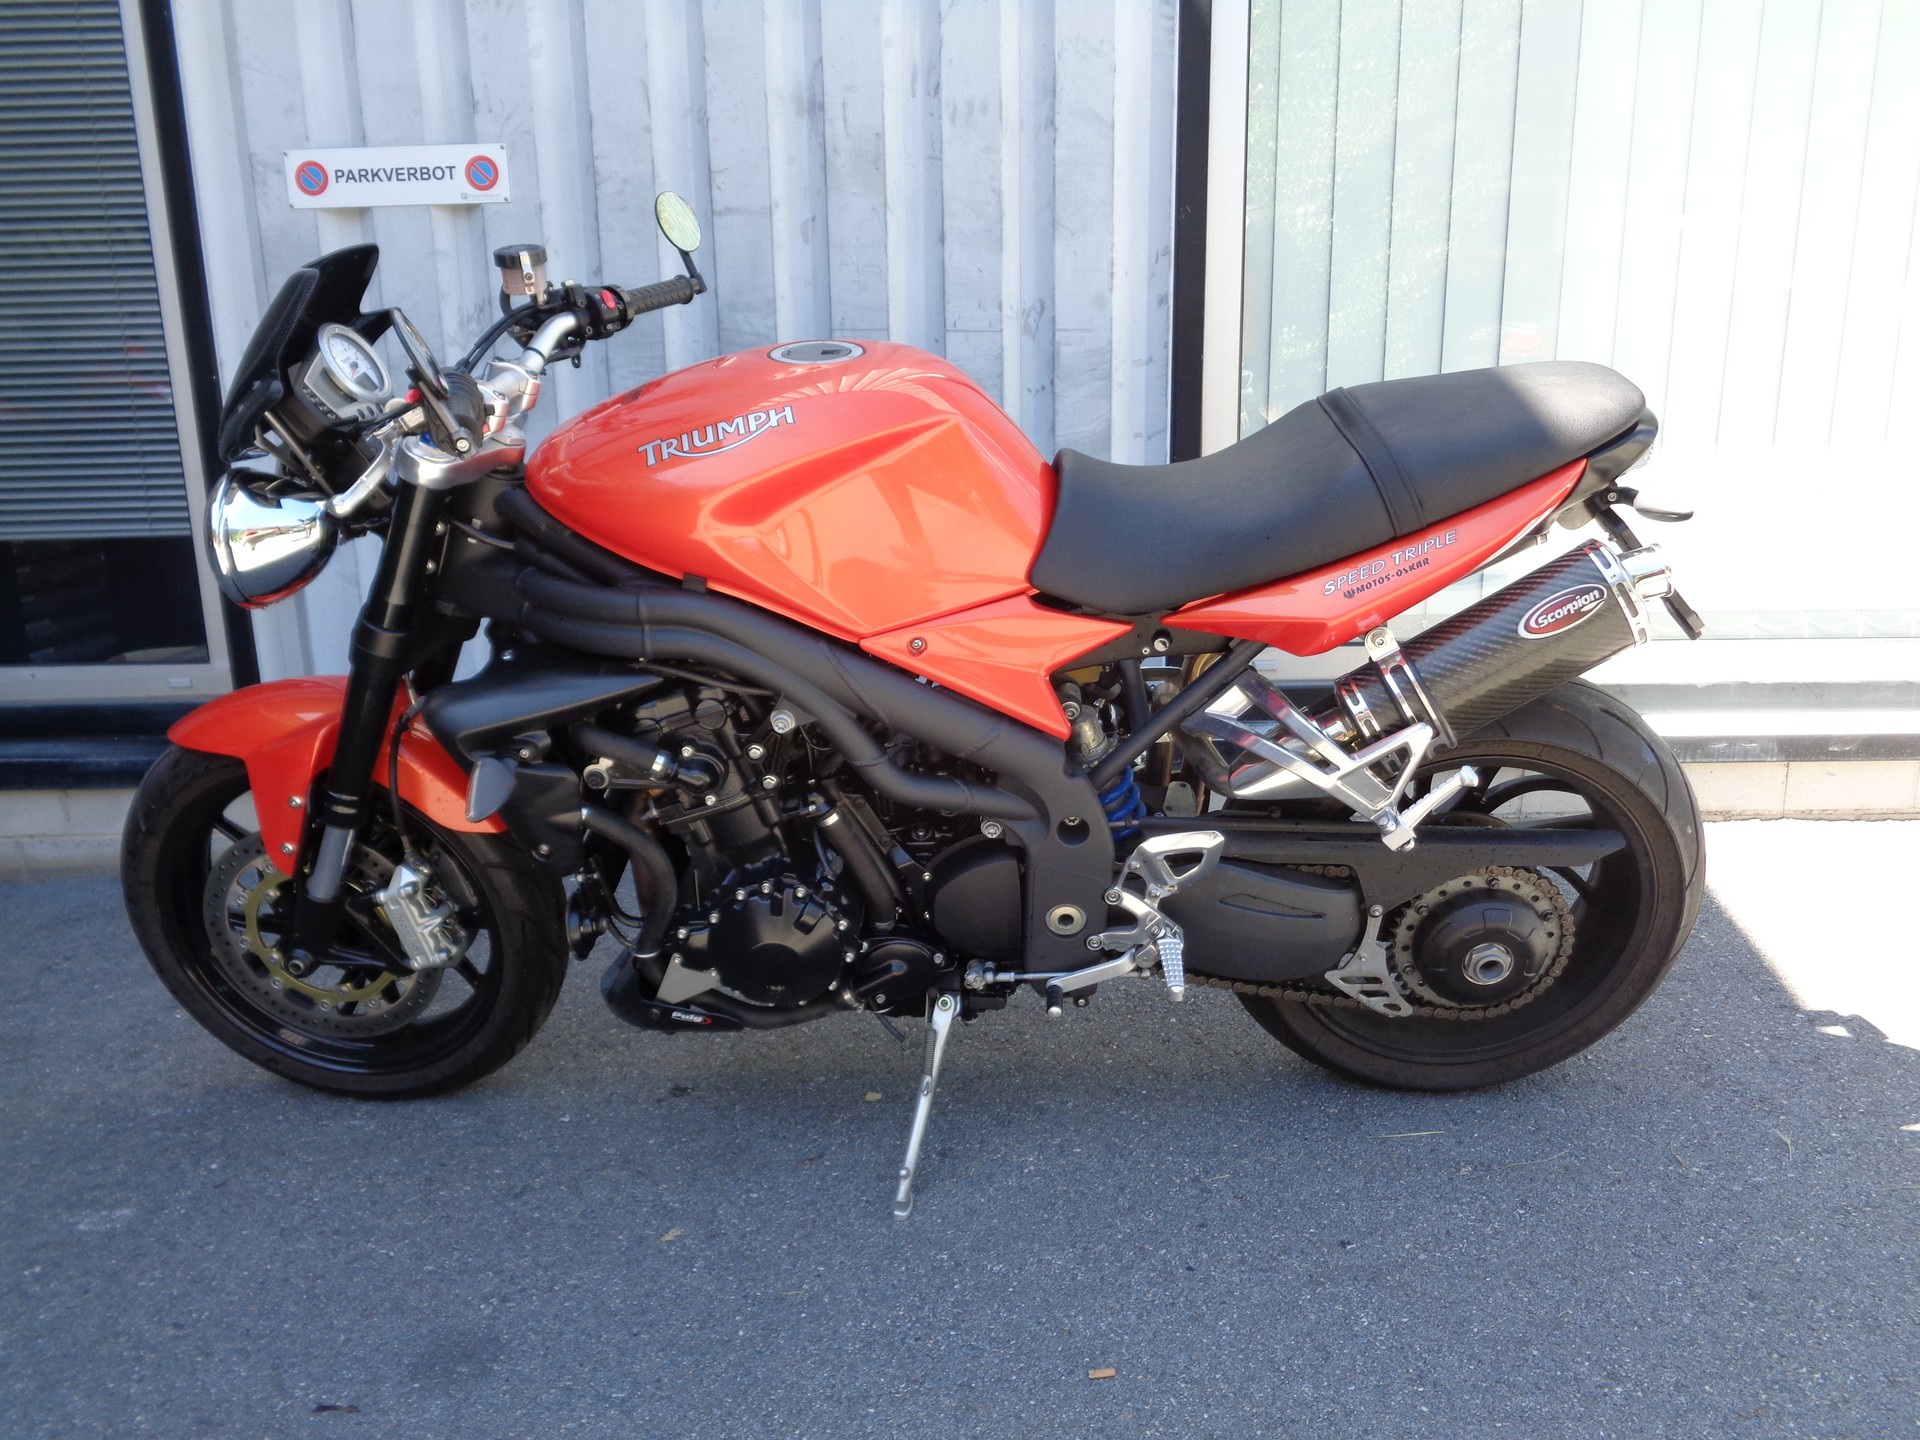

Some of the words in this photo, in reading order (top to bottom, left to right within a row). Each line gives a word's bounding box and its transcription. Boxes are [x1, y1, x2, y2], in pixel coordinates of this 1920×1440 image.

[334, 166, 456, 184] PARKVERBOT
[637, 405, 796, 467] TRIUMPH
[1323, 559, 1387, 596] SPEED
[1391, 529, 1458, 566] TRIPLE
[1356, 557, 1430, 594] MOTOS-OSKAR
[1537, 589, 1600, 628] Scorpion
